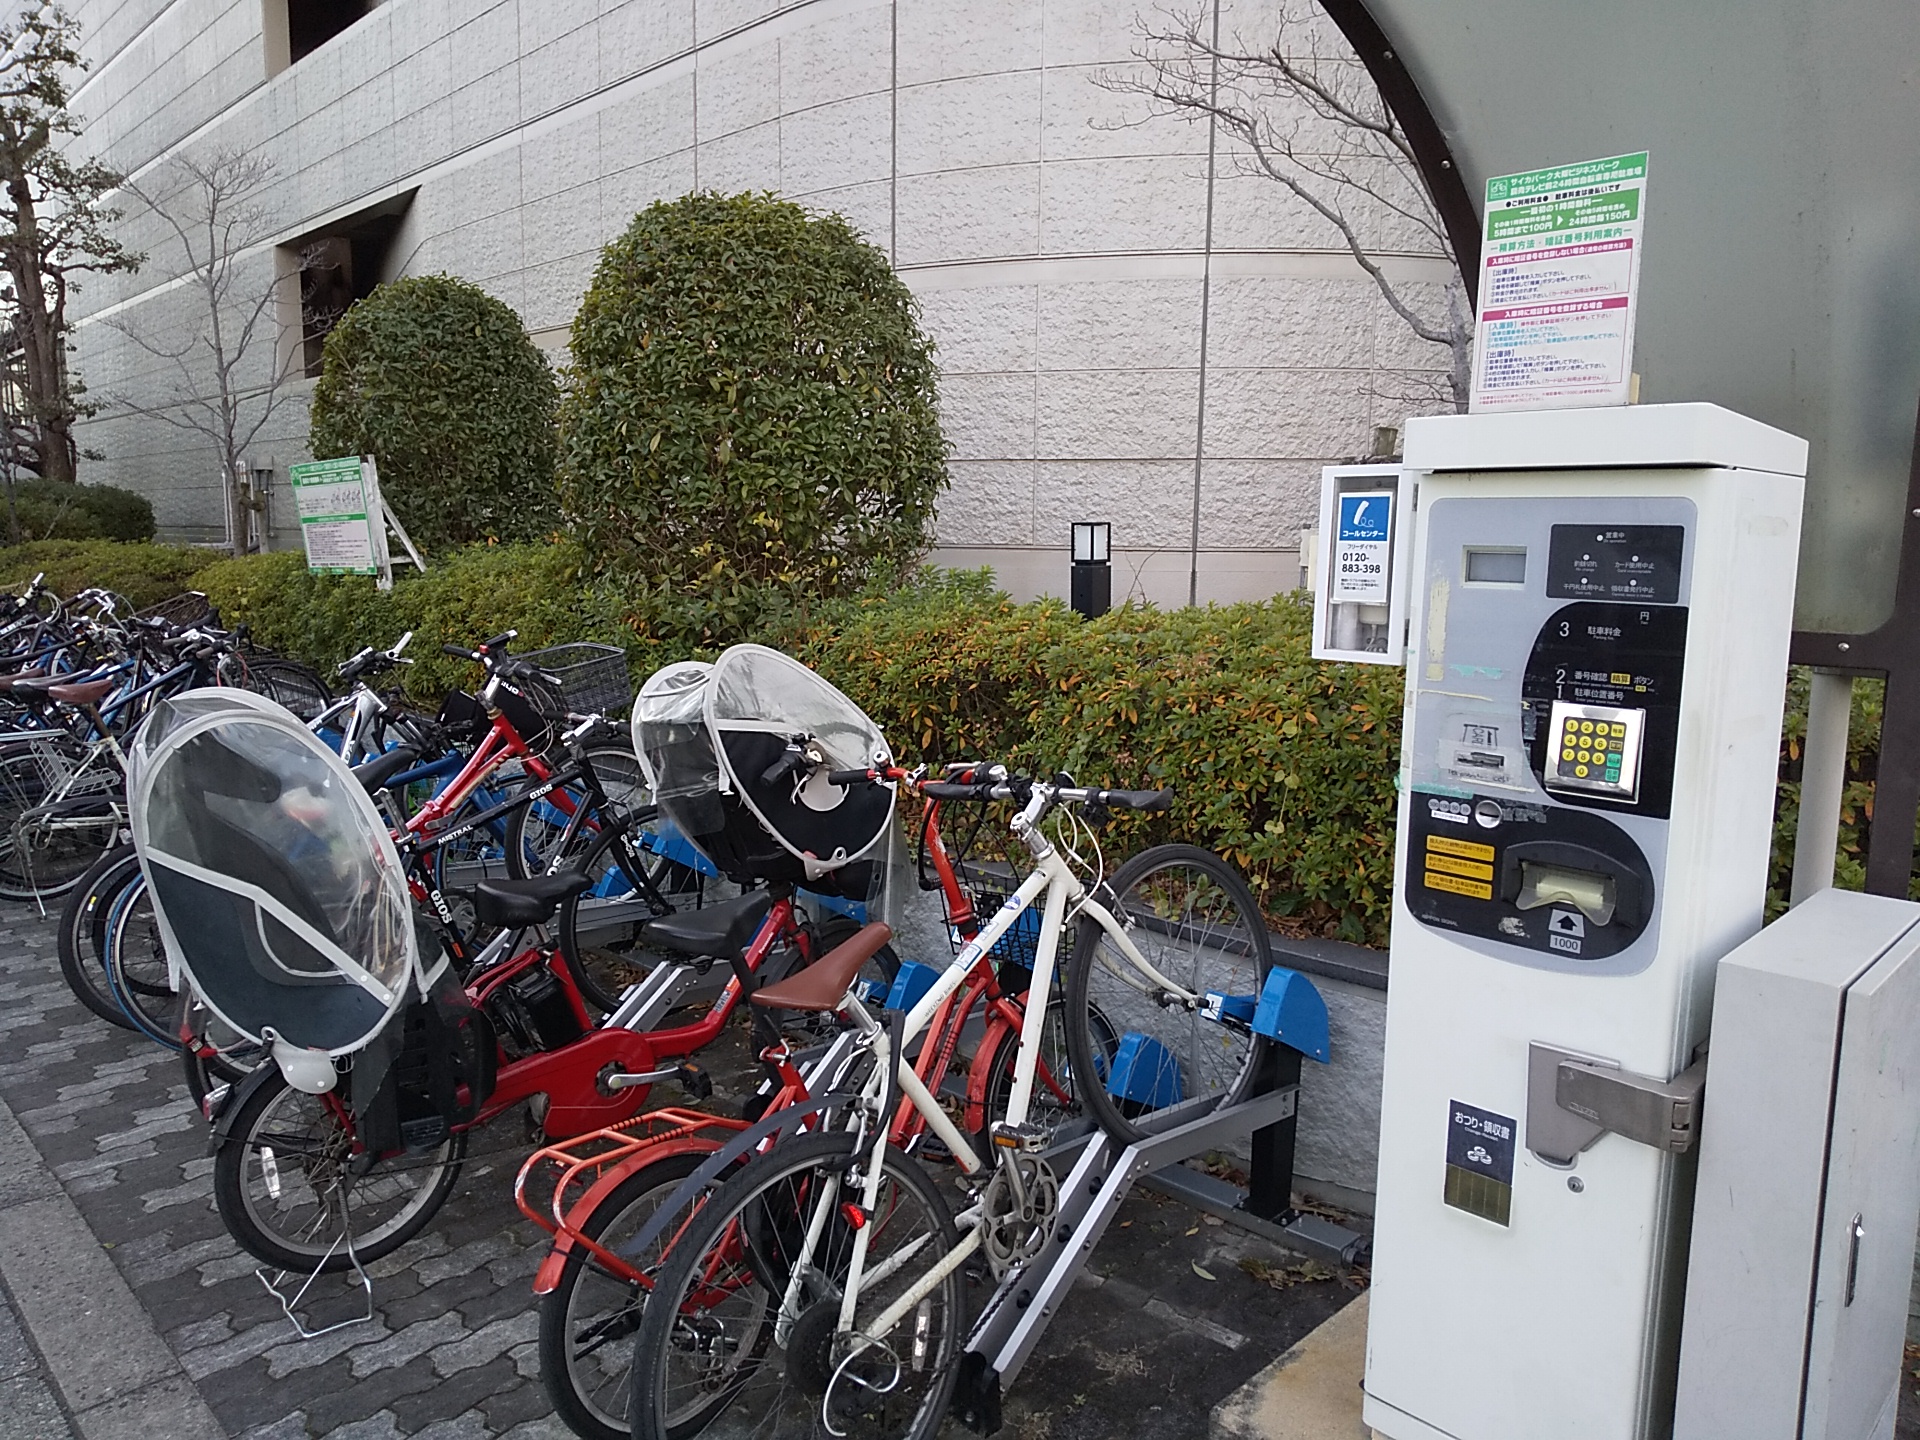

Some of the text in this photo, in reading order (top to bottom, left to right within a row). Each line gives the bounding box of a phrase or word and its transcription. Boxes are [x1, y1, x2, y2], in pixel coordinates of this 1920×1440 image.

[1511, 162, 1619, 185] サイカパーク大阪ビジネスパーク
[1569, 211, 1630, 225] 24時間毎150円
[1494, 223, 1552, 236] 5時間まで100円
[1342, 530, 1385, 538] コールセンター
[1605, 531, 1625, 539] 営業中
[1342, 553, 1369, 562] 0120-
[1342, 564, 1381, 573] 883-398
[1615, 561, 1655, 569] カード使用中止
[1563, 583, 1605, 592] 千円札使用中止
[1611, 585, 1655, 593] 領収書発行中止
[1640, 611, 1649, 621] 円
[1560, 622, 1569, 637] 3
[1587, 626, 1622, 637] 駐車料金
[1556, 669, 1654, 685] 2 番号確認 精算 ボタン
[1556, 685, 1624, 700] 1 駐車位置番号
[1472, 728, 1484, 745] CAR
[529, 784, 553, 799] GIOS
[438, 825, 473, 845] MISTRAL
[430, 889, 453, 924] GIOS
[1554, 937, 1578, 950] 1000
[1455, 1111, 1510, 1140] おつり・領収書
